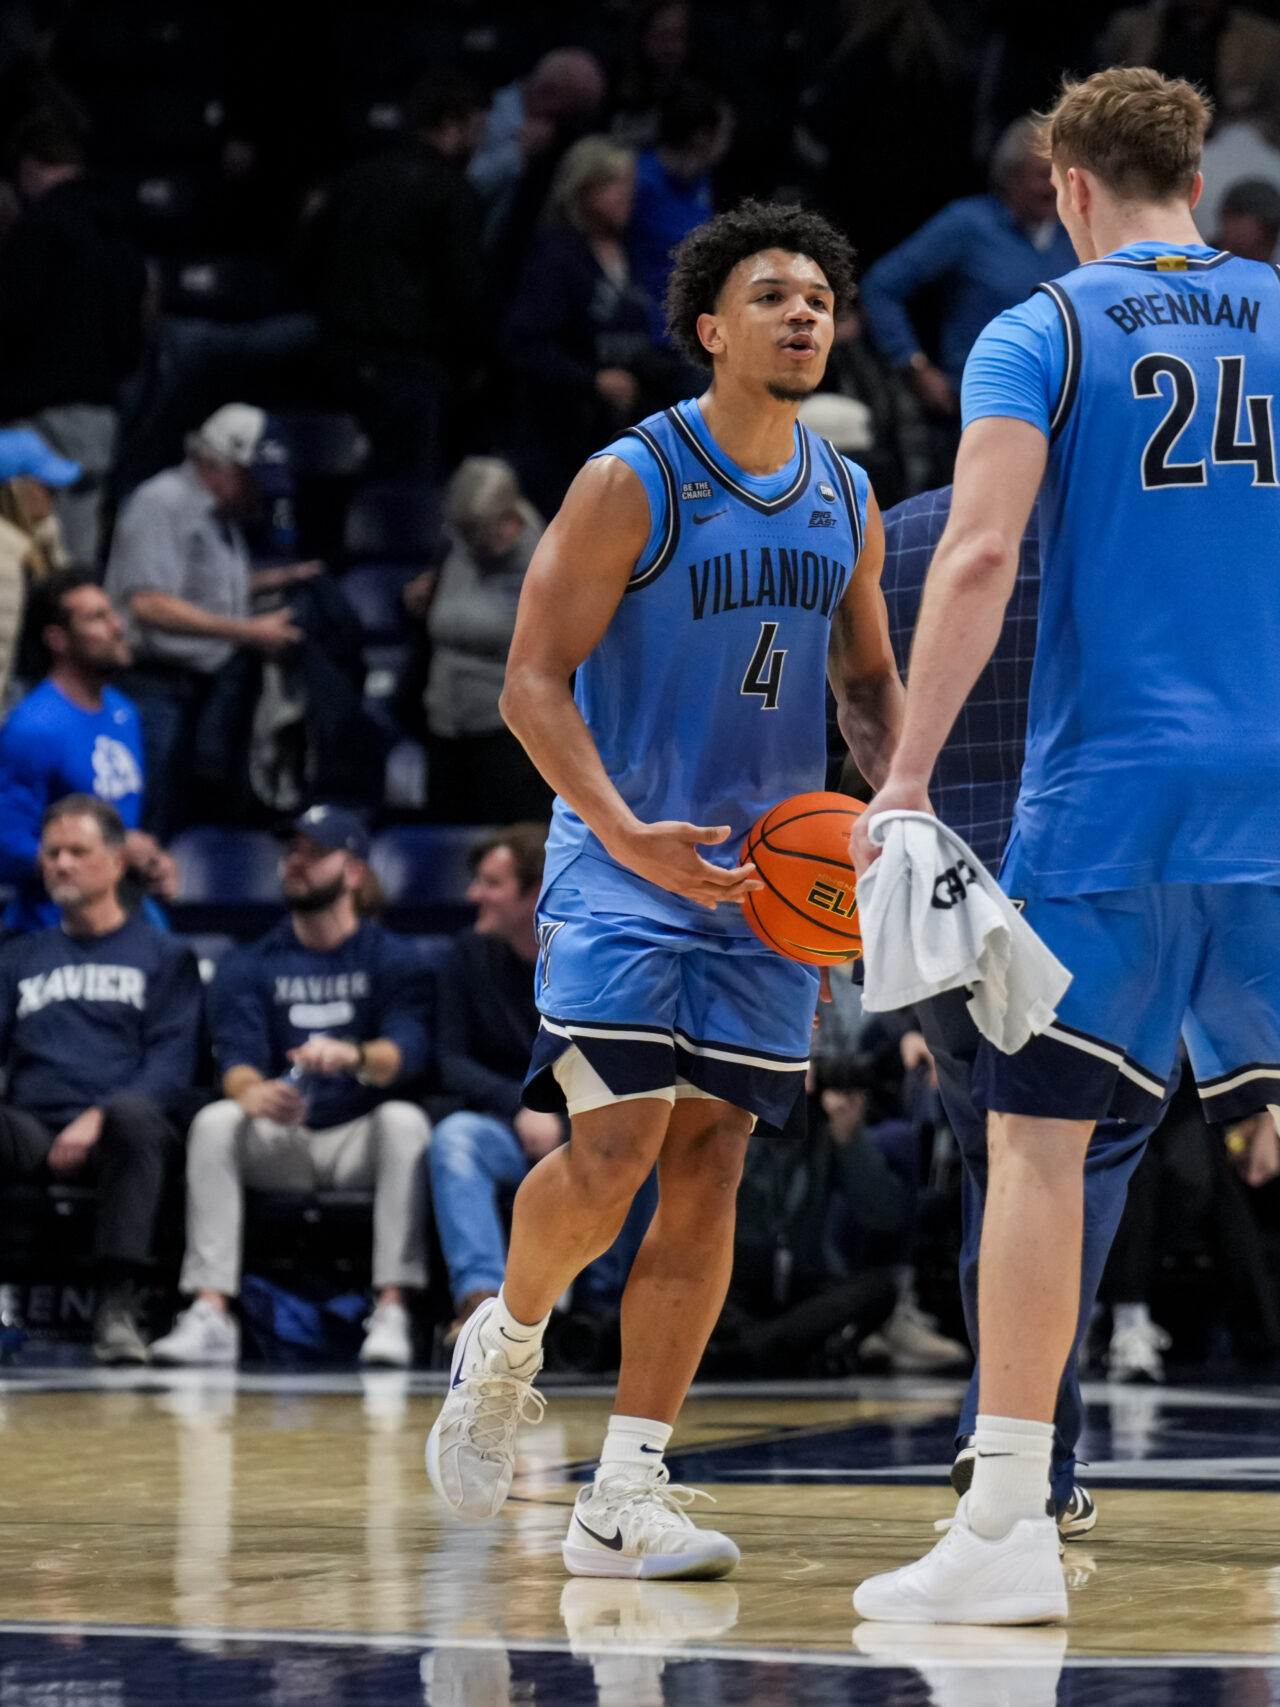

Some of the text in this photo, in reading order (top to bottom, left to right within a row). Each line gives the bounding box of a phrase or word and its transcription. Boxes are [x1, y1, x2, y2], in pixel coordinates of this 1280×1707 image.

[1104, 292, 1261, 335] BRENNAN
[1131, 352, 1280, 491] 24
[681, 489, 713, 500] CHANGE
[682, 481, 709, 492] BE THE
[811, 510, 832, 519] BIG
[740, 621, 788, 711] 4
[806, 880, 859, 920] ELI
[16, 963, 147, 1019] XAVIER
[274, 971, 369, 1005] XAVIER
